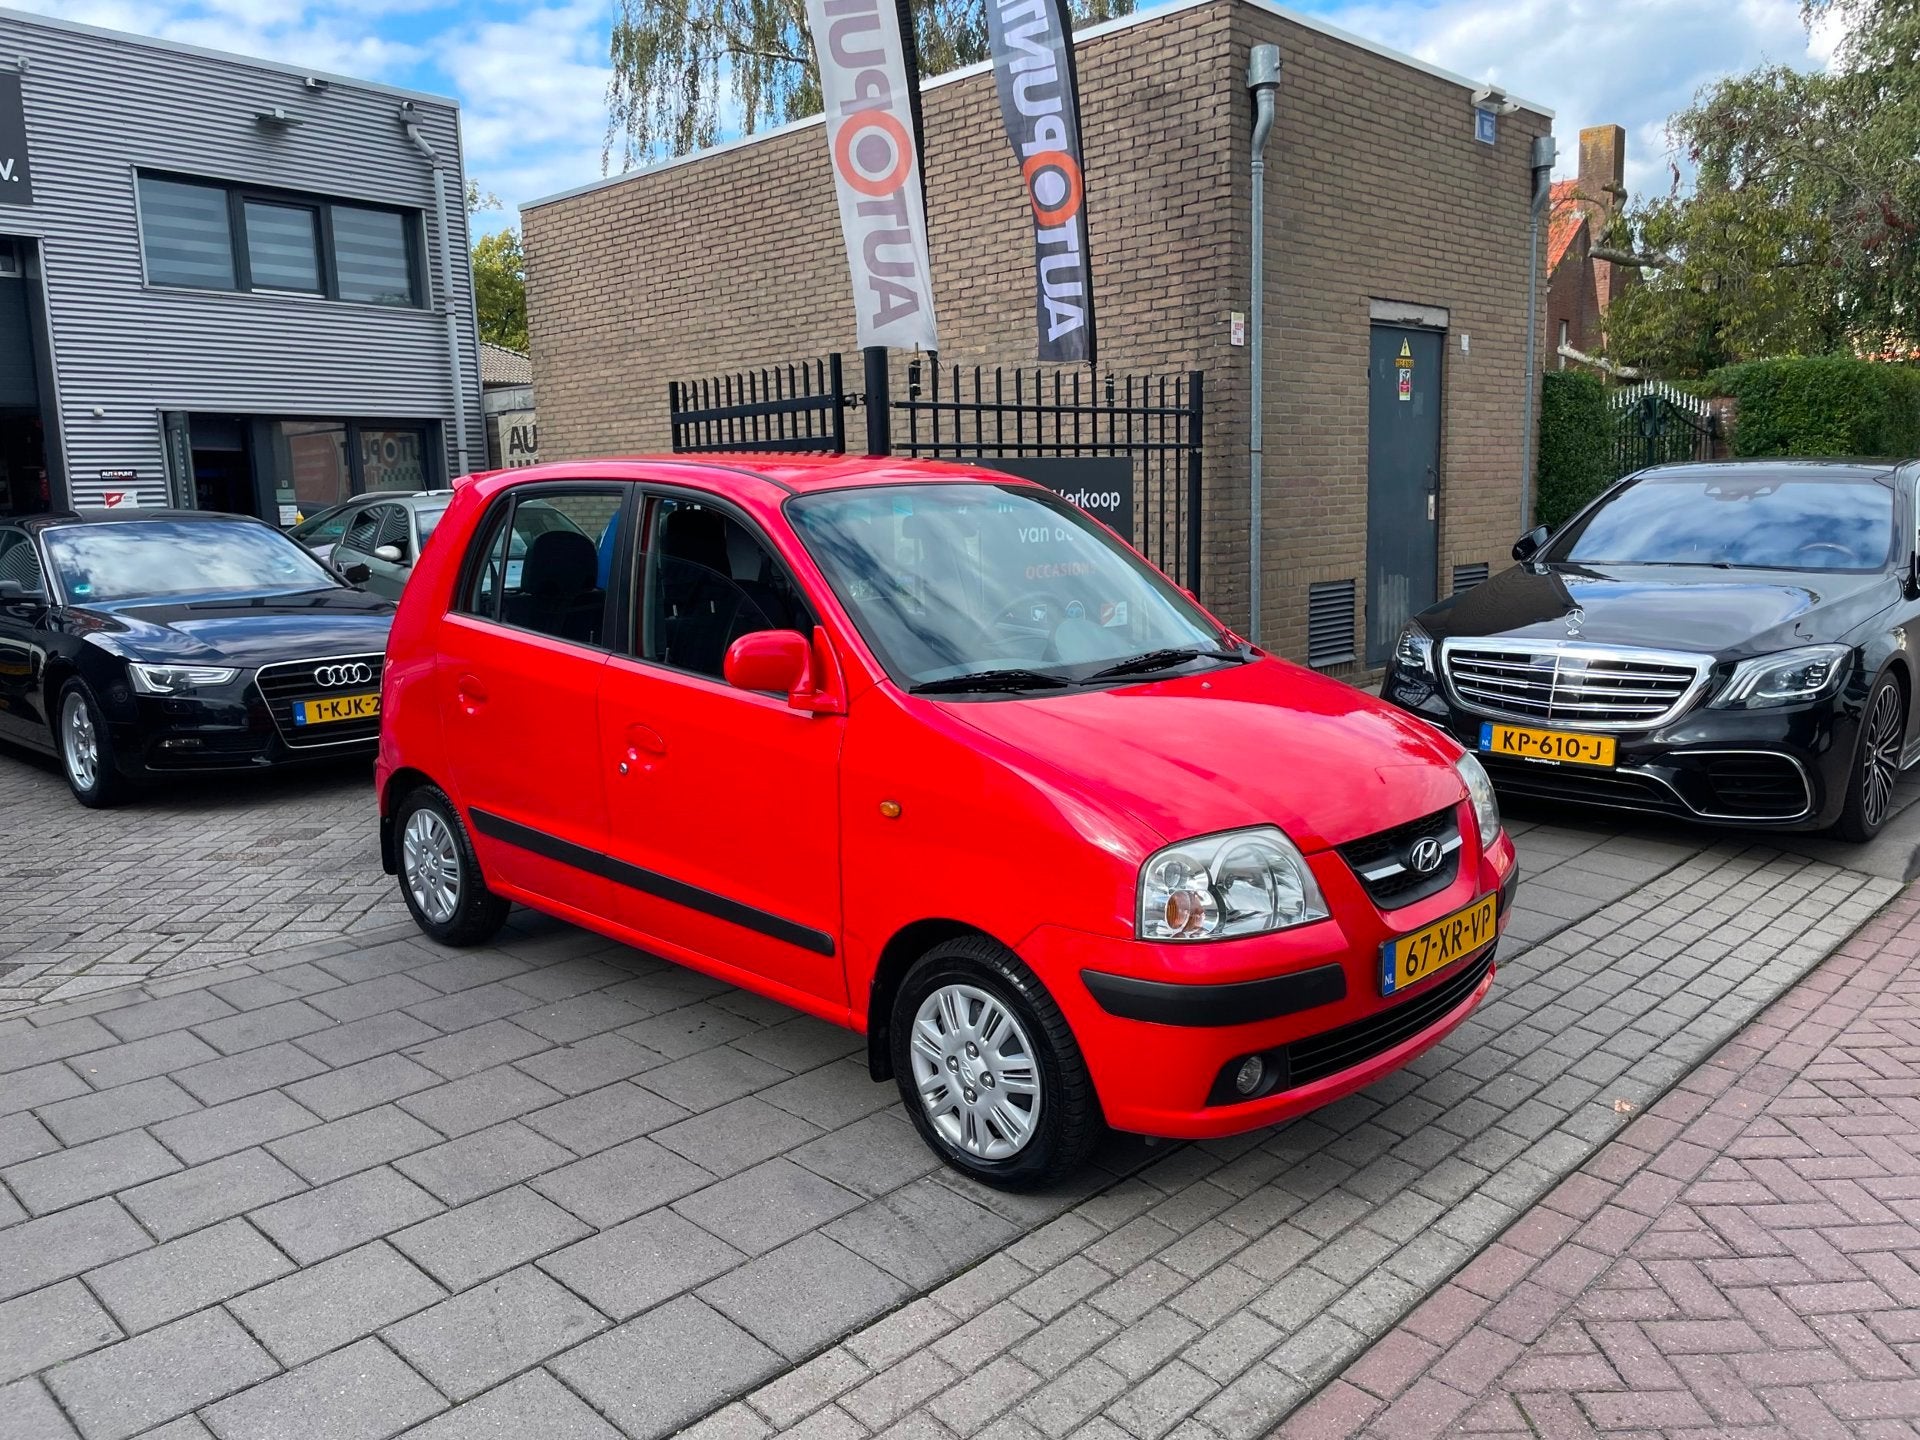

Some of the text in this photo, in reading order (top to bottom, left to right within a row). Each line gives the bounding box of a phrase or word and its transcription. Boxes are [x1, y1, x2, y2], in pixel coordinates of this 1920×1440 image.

[1018, 527, 1049, 543] van
[1503, 730, 1602, 760] KP-610-J
[1405, 903, 1491, 977] 67-XR-VP
[1384, 973, 1394, 986] NL
